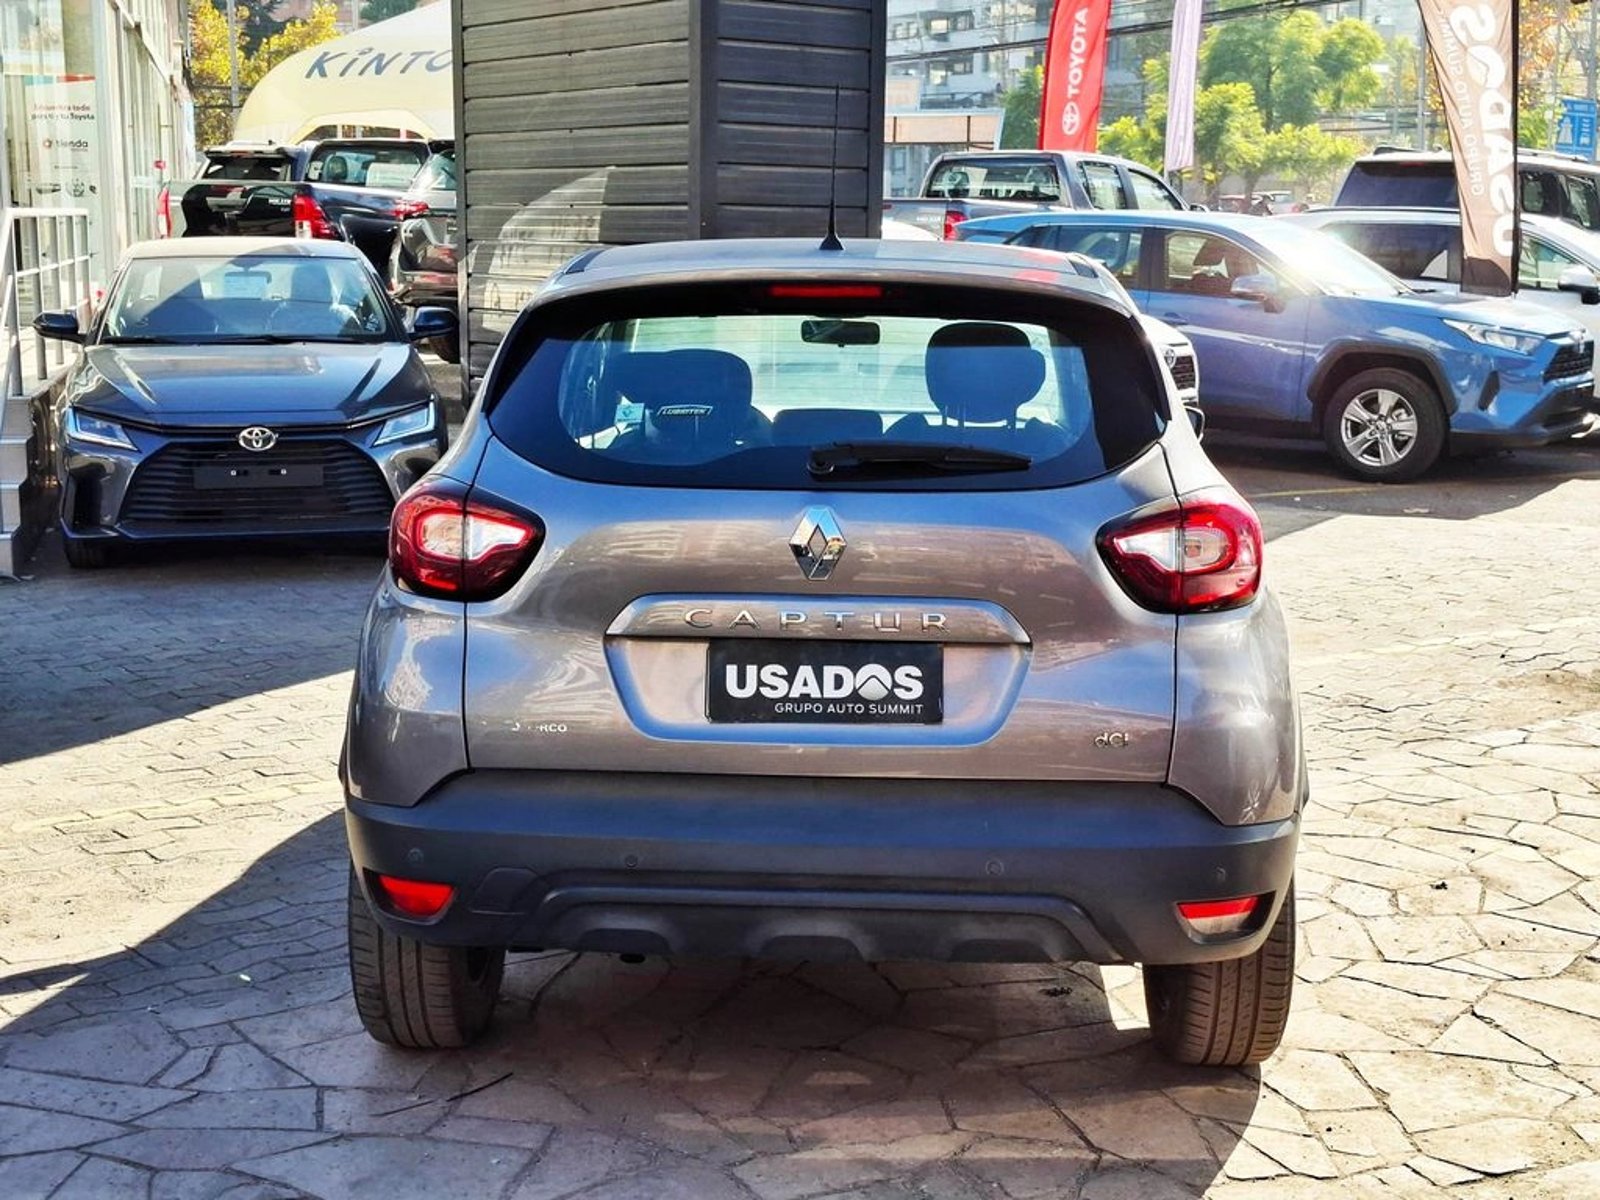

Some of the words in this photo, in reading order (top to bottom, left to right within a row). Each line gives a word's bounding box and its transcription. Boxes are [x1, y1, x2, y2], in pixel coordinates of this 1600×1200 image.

[1068, 8, 1088, 97] TOYOTA
[684, 608, 951, 634] CAPTUR
[726, 663, 924, 700] USADOS
[774, 703, 823, 714] GRUPO
[827, 703, 865, 714] AUTO
[868, 703, 924, 715] SUMMIT
